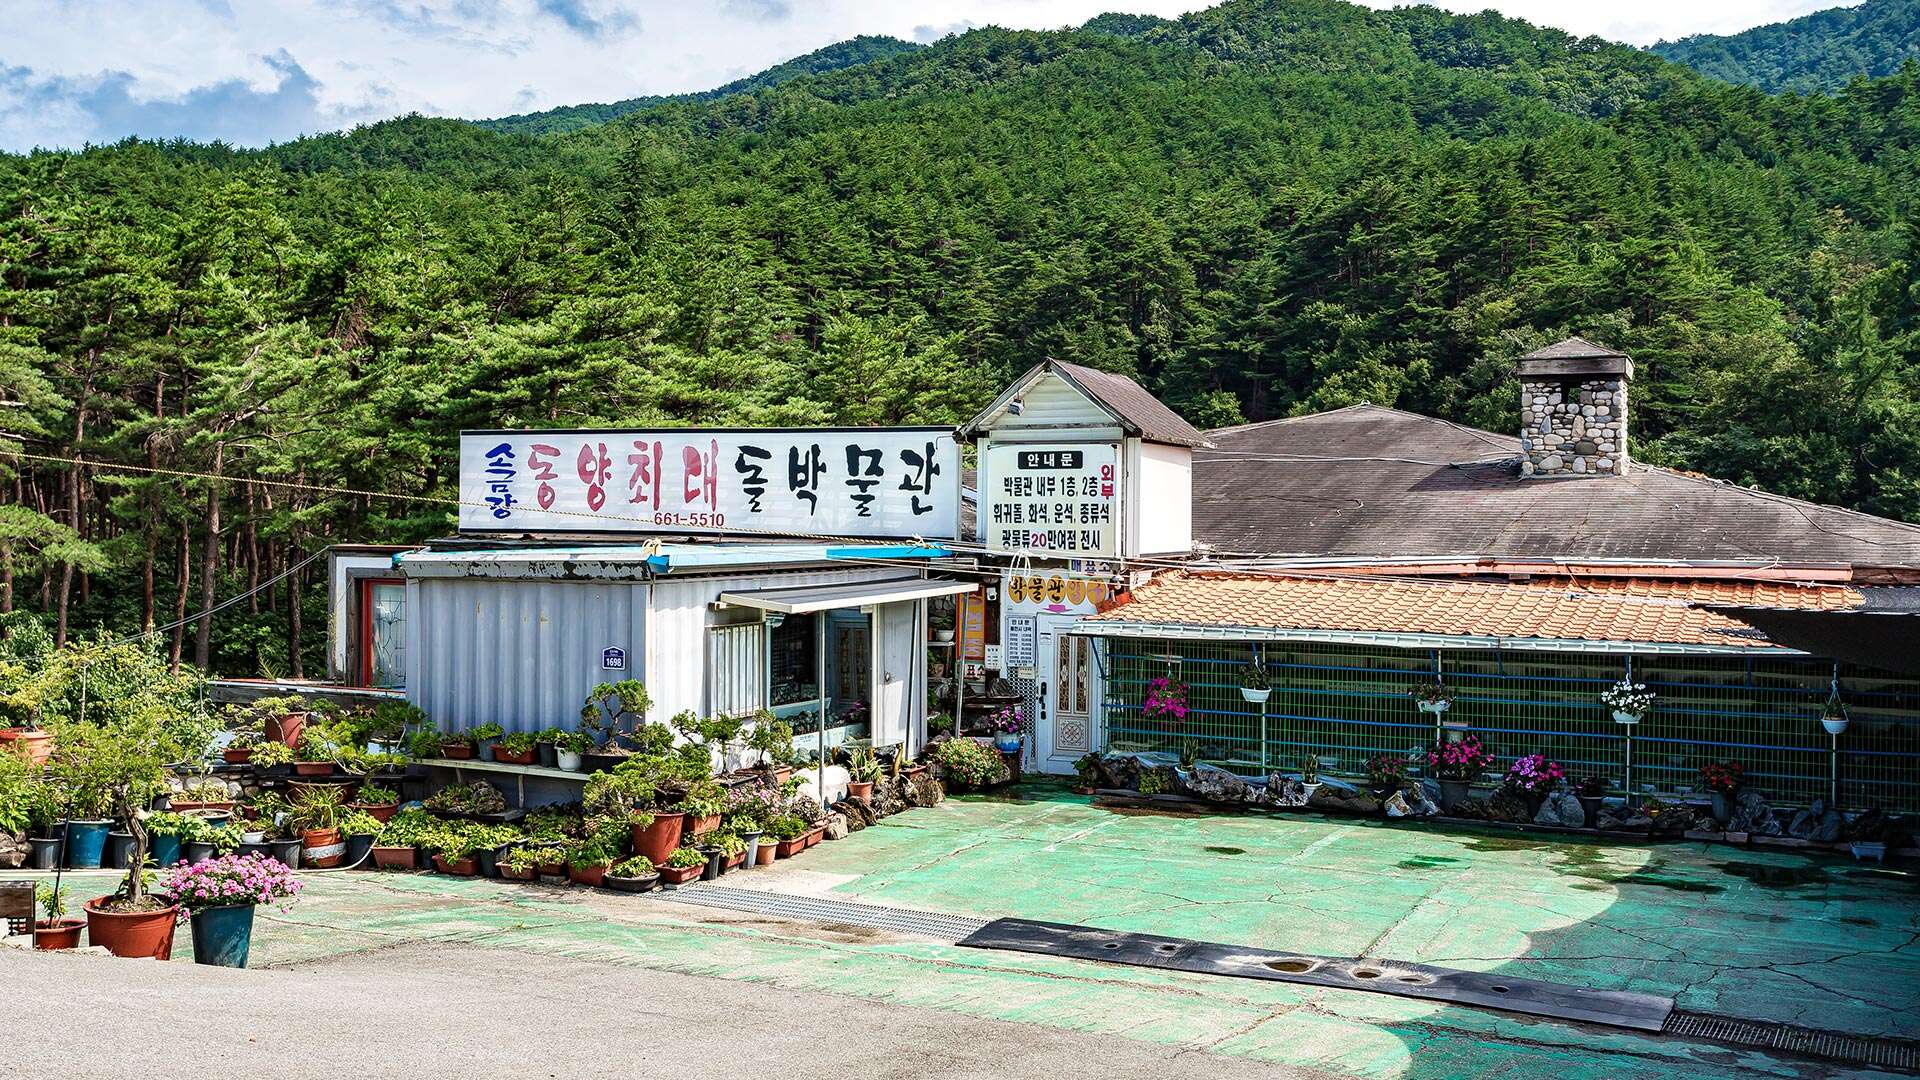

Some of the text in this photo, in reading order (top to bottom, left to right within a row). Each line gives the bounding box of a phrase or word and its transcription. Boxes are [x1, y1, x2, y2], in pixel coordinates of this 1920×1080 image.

[485, 443, 518, 519] 소금강
[527, 439, 941, 517] 동양최대 돌박물관
[1004, 476, 1033, 497] 박물관
[1037, 476, 1056, 497] 내부
[1082, 477, 1098, 497] 2층
[1101, 464, 1114, 500] 외부
[654, 511, 725, 527] 661-5510
[1080, 503, 1109, 524] 종류석
[1081, 529, 1100, 550] 전시
[606, 657, 622, 667] 1698
